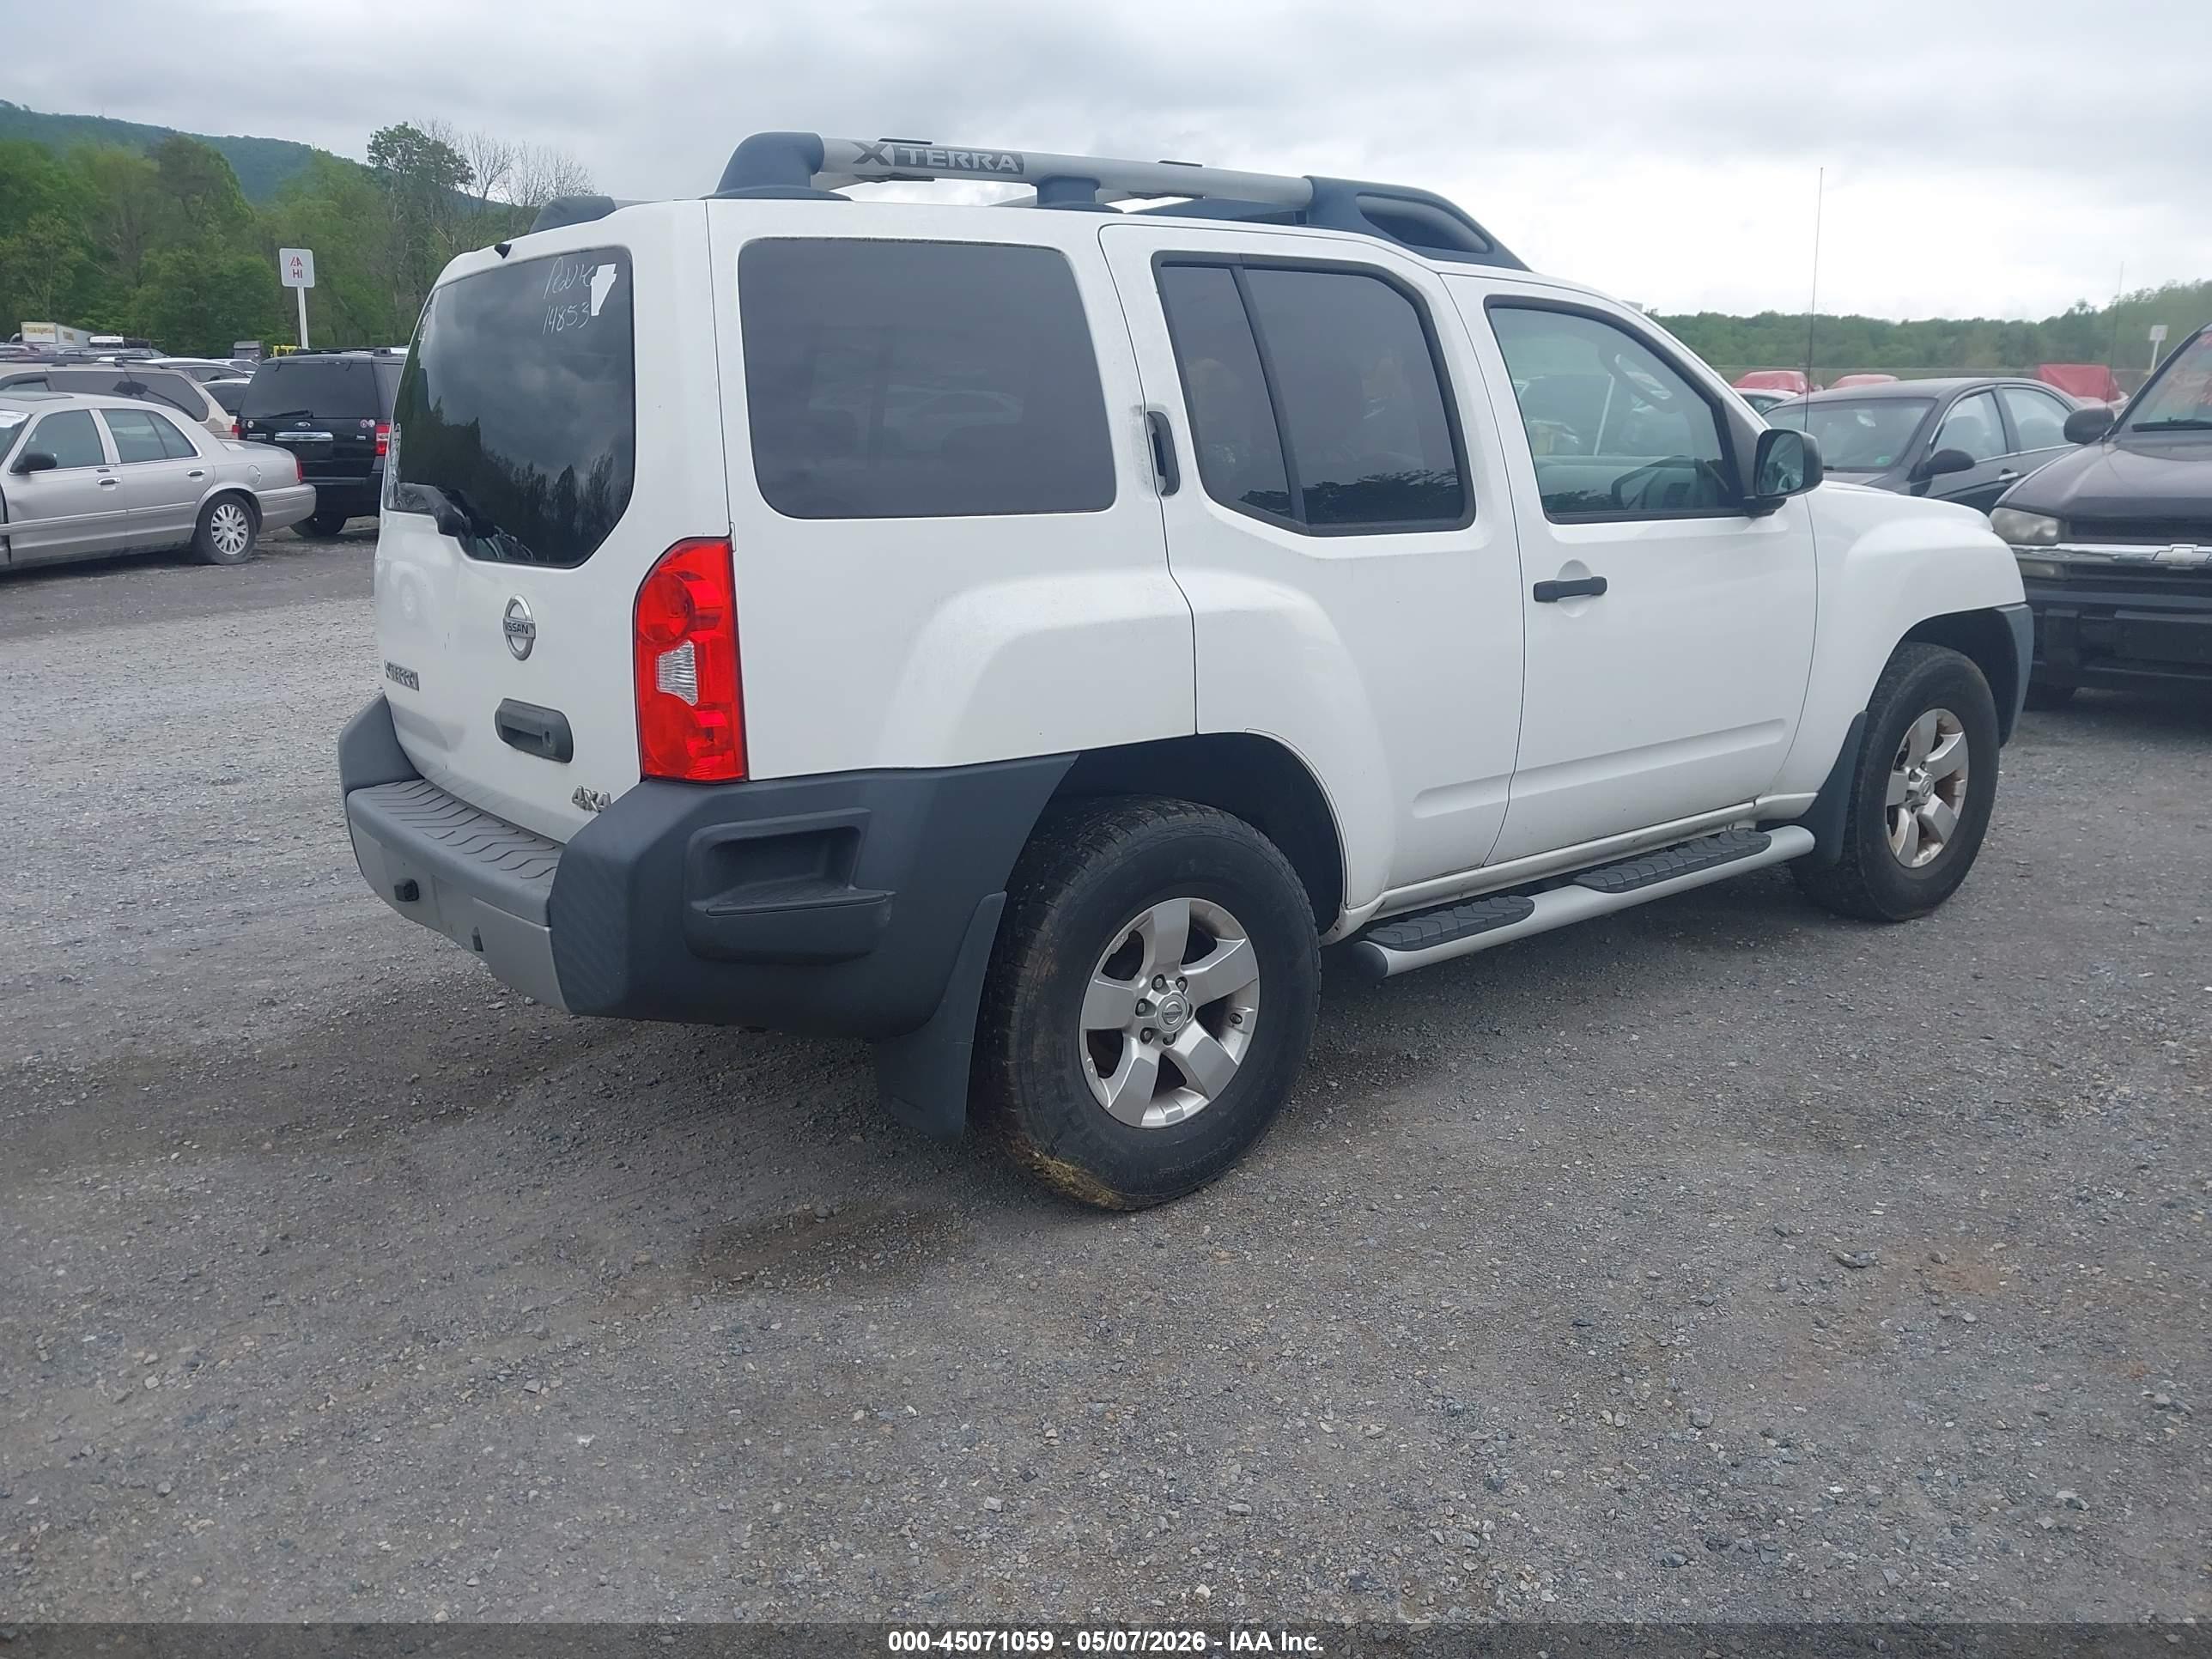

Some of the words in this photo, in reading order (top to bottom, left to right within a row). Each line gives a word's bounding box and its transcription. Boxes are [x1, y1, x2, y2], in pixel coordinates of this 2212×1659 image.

[851, 141, 1019, 173] XTERRA
[292, 268, 303, 279] HI
[542, 301, 590, 336] 14853
